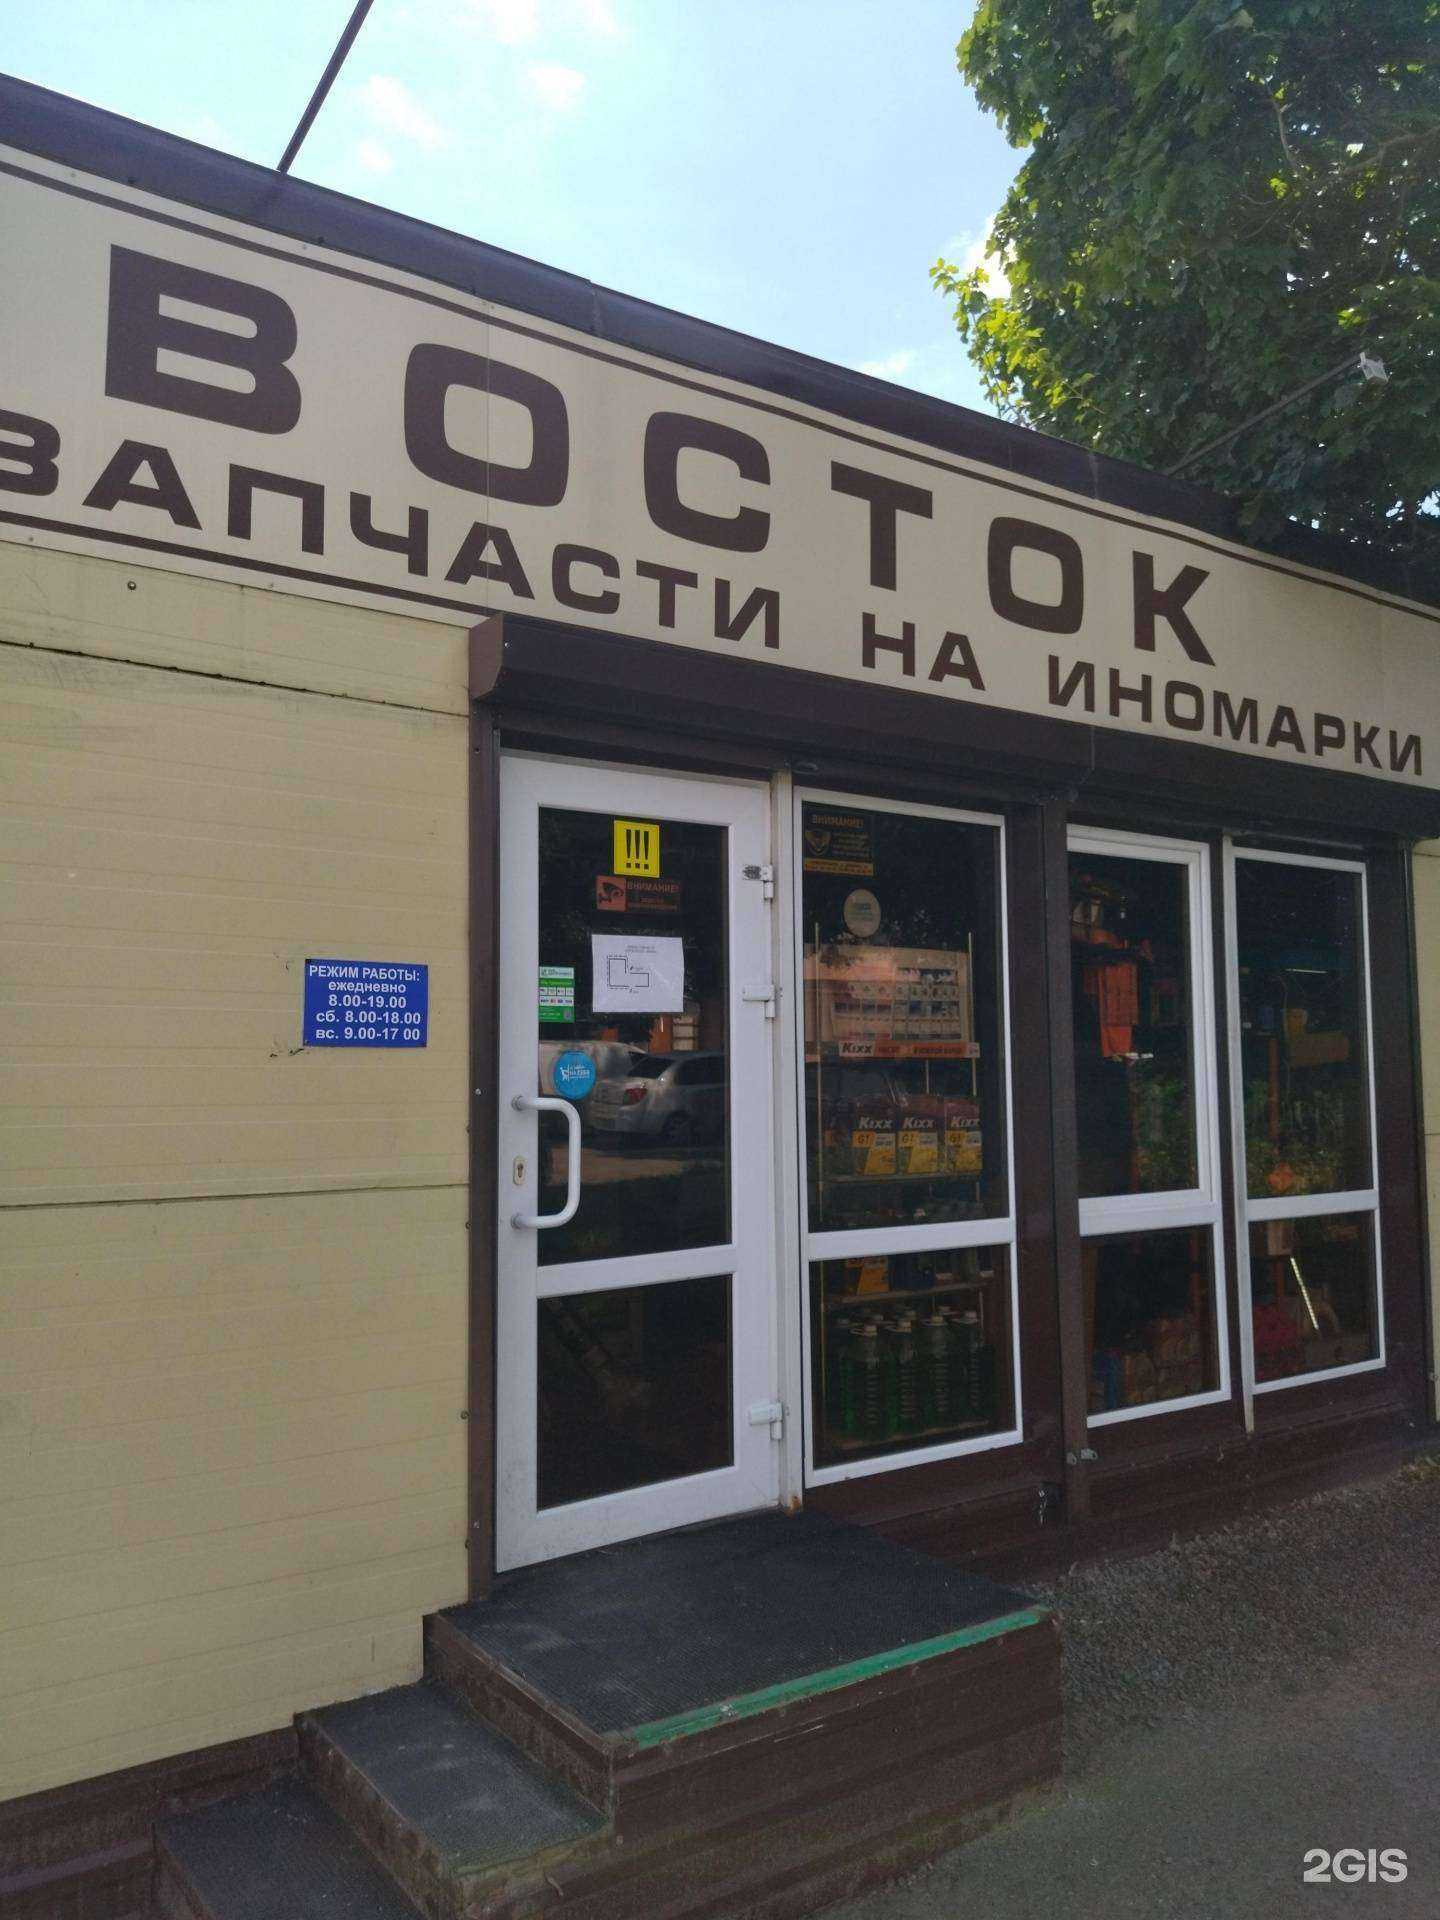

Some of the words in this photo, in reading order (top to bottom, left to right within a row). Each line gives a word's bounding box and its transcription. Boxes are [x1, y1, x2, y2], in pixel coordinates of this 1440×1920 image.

[105, 243, 1215, 666] ВОСТОК
[0, 409, 780, 649] ЗАПЧАСТИ
[862, 611, 985, 692] НА
[1048, 654, 1423, 776] ИНОМАРКИ
[309, 965, 358, 979] РЕЖИМ
[362, 967, 420, 981] РАБОТЫ:
[328, 981, 407, 994] ежедневно
[328, 994, 407, 1009] 8.00-19.00
[316, 1010, 340, 1023] сб.
[345, 1011, 421, 1025] 8.00-18.00
[315, 1029, 339, 1039] вс.
[842, 1042, 873, 1054] Kixx
[859, 1116, 893, 1129] Kixx
[903, 1116, 935, 1129] Kixx
